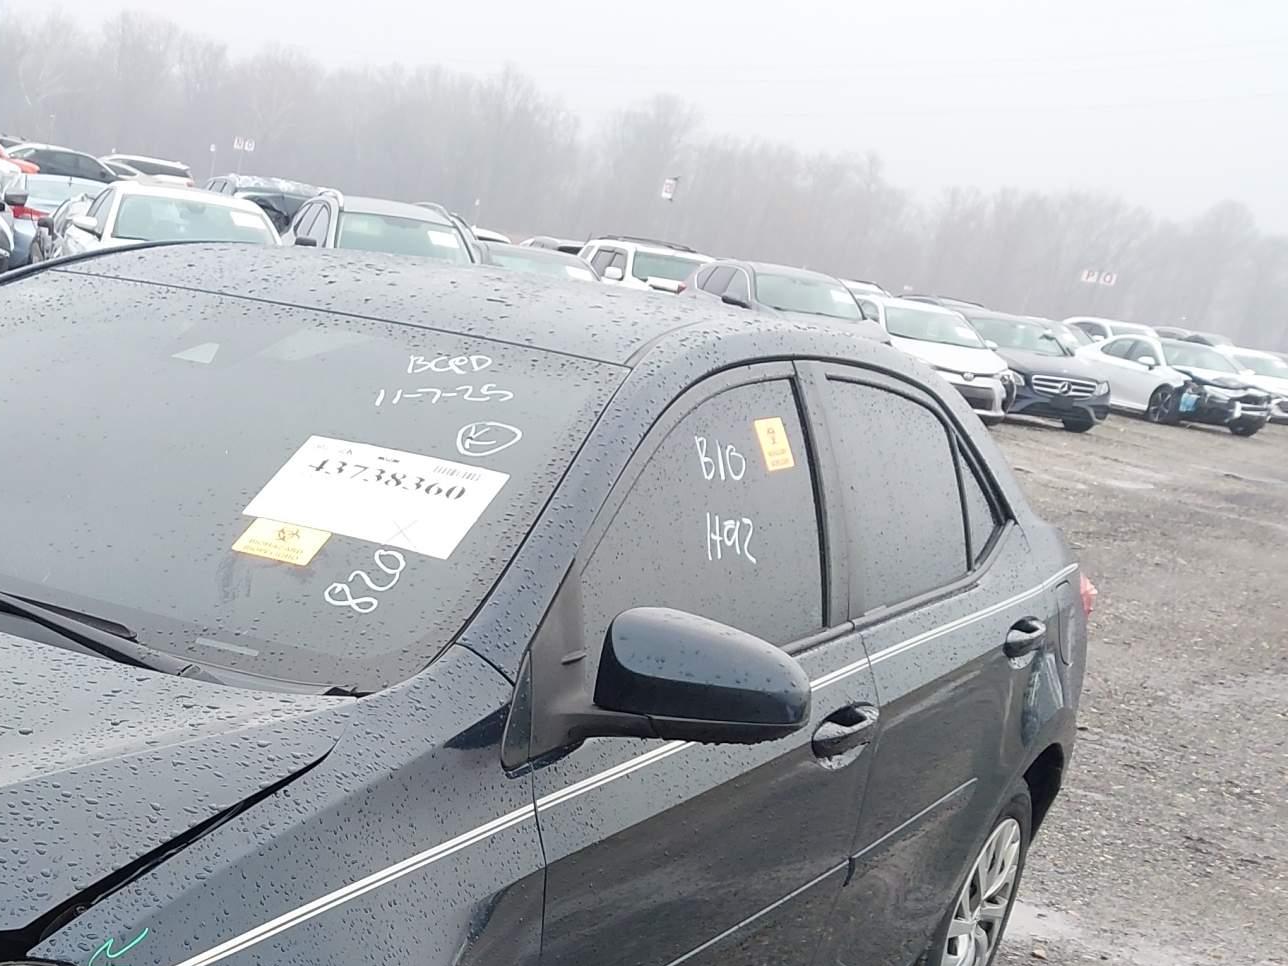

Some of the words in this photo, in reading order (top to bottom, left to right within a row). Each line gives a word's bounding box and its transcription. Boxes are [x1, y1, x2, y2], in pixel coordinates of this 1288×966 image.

[375, 384, 514, 406] 11-7-25
[308, 459, 466, 500] 43738360
[324, 549, 406, 614] 820
